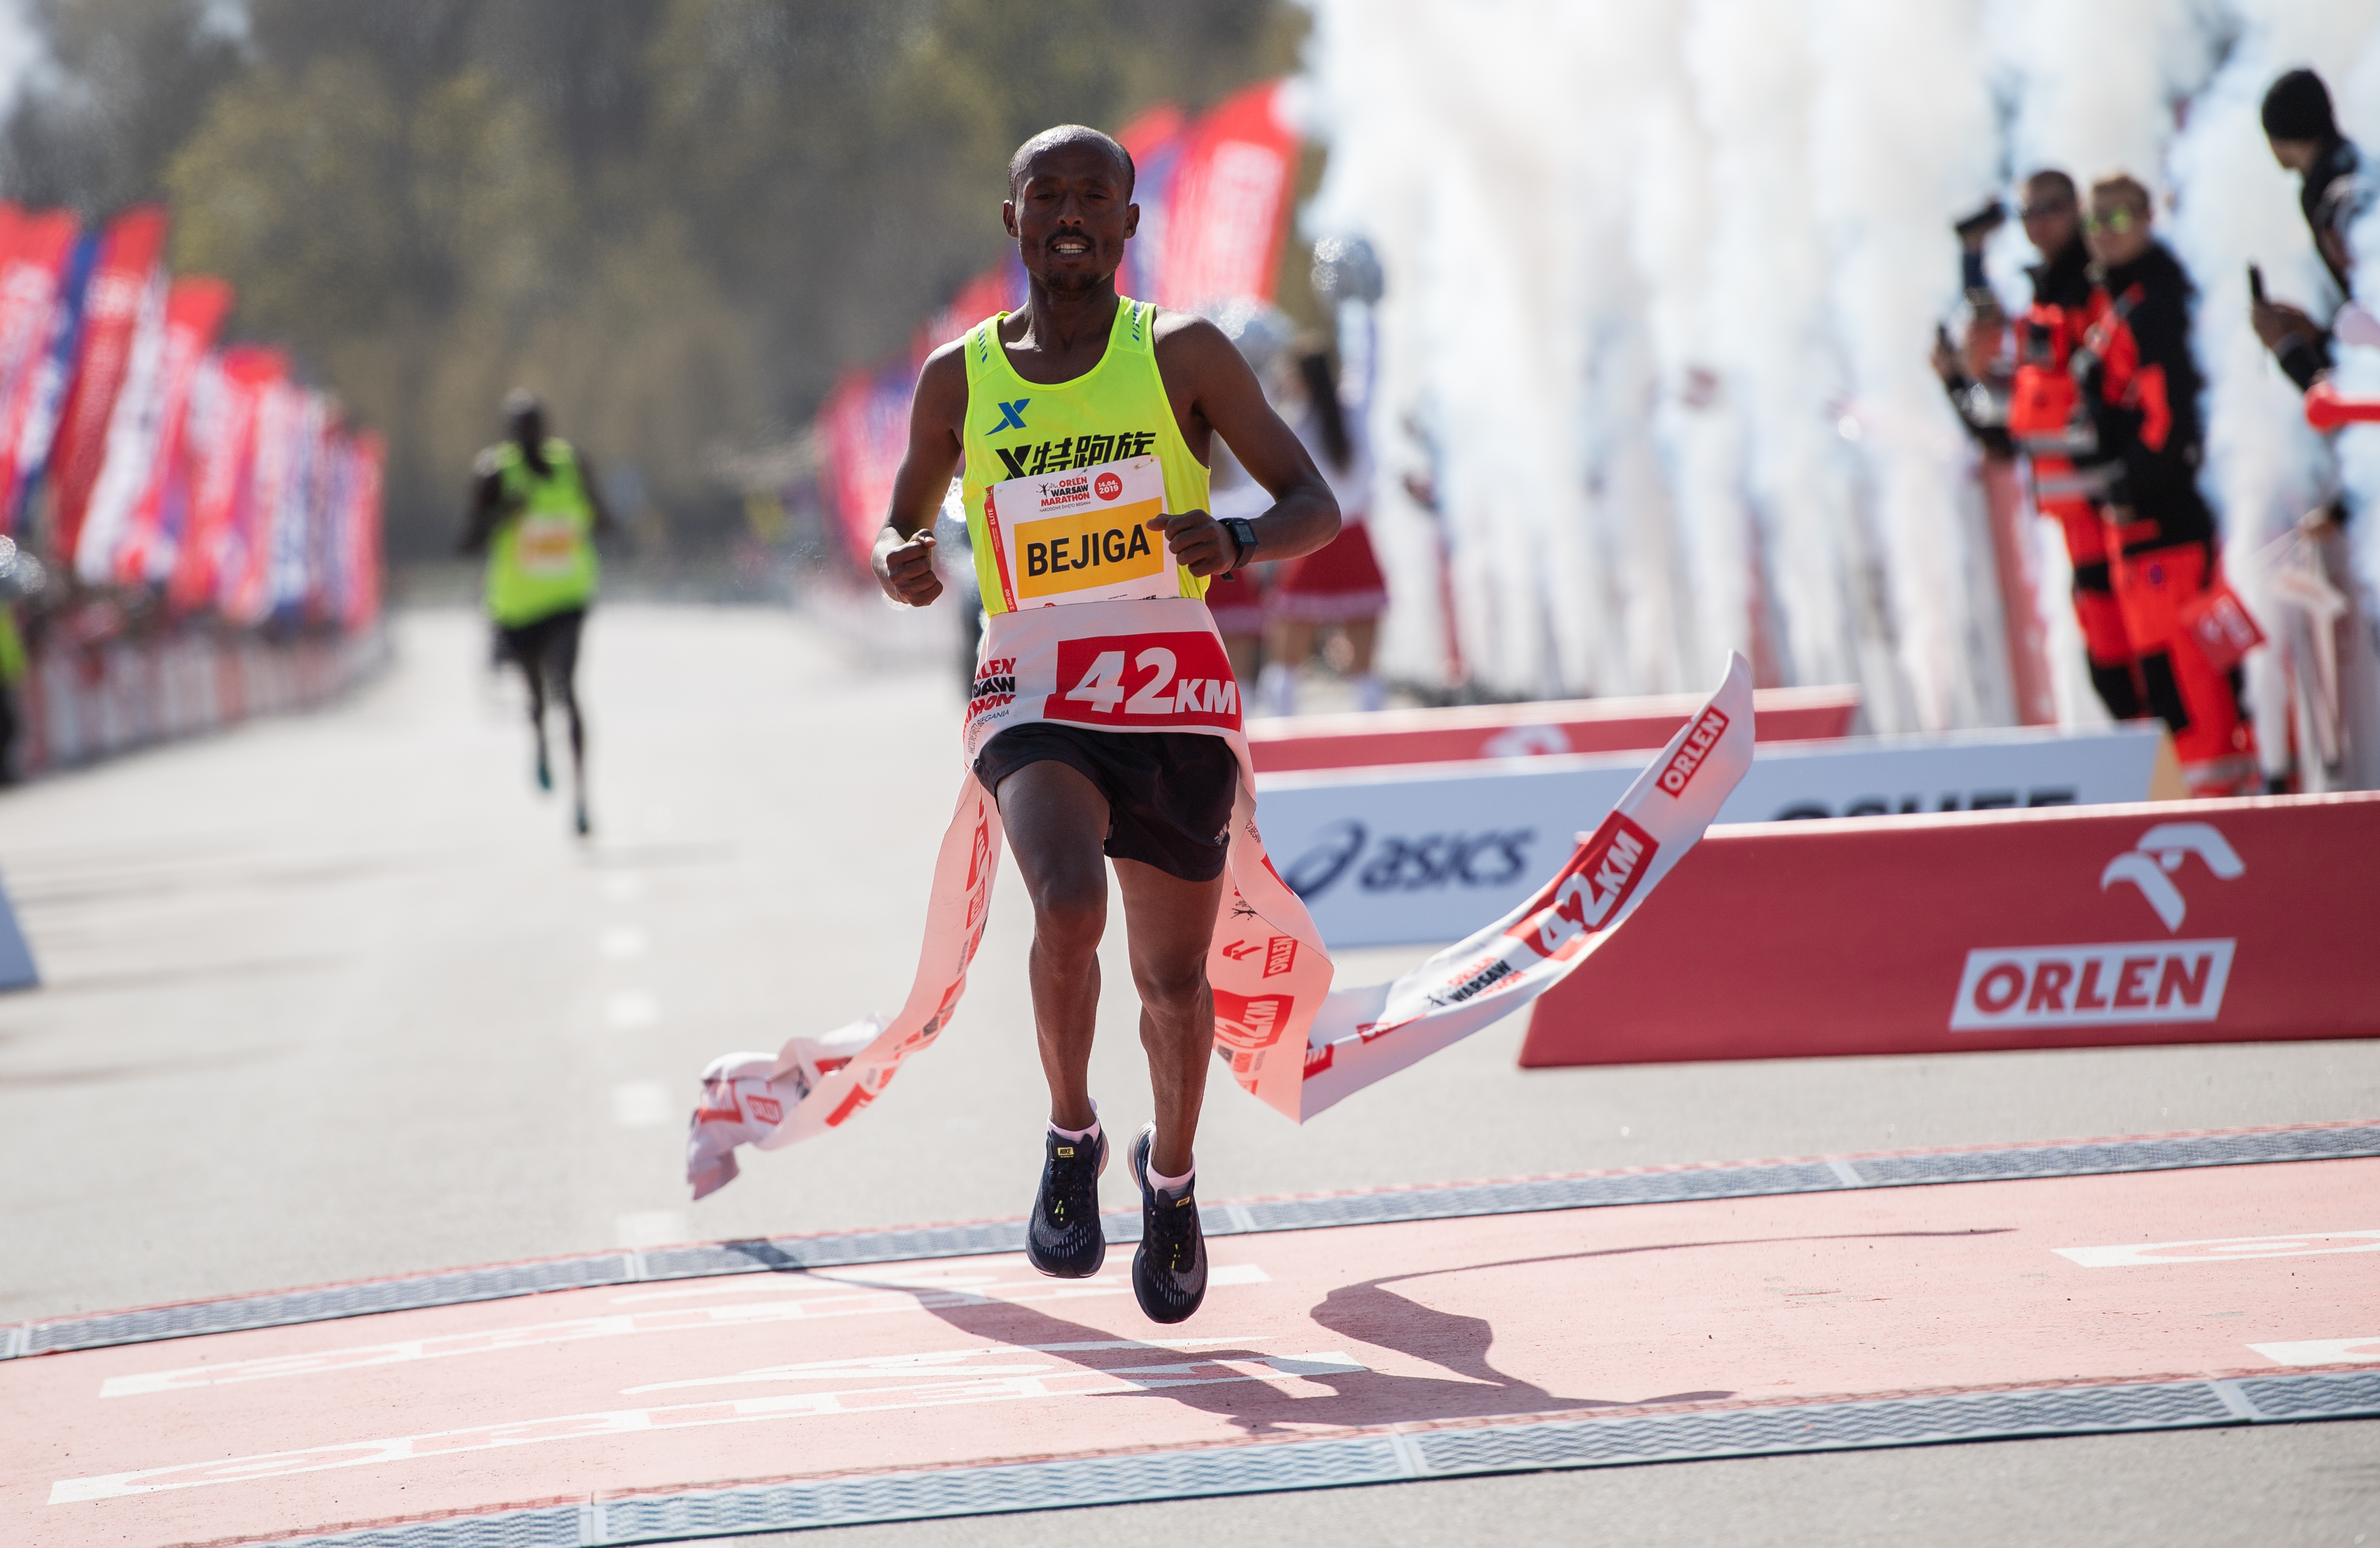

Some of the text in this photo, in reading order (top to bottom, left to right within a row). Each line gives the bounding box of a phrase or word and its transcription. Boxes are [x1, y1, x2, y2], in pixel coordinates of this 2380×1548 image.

[1051, 485, 1089, 497] WARSAW
[1059, 476, 1087, 487] ORLEN
[1099, 485, 1119, 494] 2019
[1041, 492, 1090, 506] MARATHON
[987, 508, 996, 525] ELITE
[1027, 523, 1151, 577] BEJIGA
[975, 658, 1017, 680] LEN
[977, 709, 1009, 728] BIEGANIA
[1664, 710, 1725, 793] ORLEN
[1268, 936, 1293, 975] ORLEN
[1448, 960, 1511, 1002] WARSAW
[1973, 954, 2214, 1017] ORLEN
